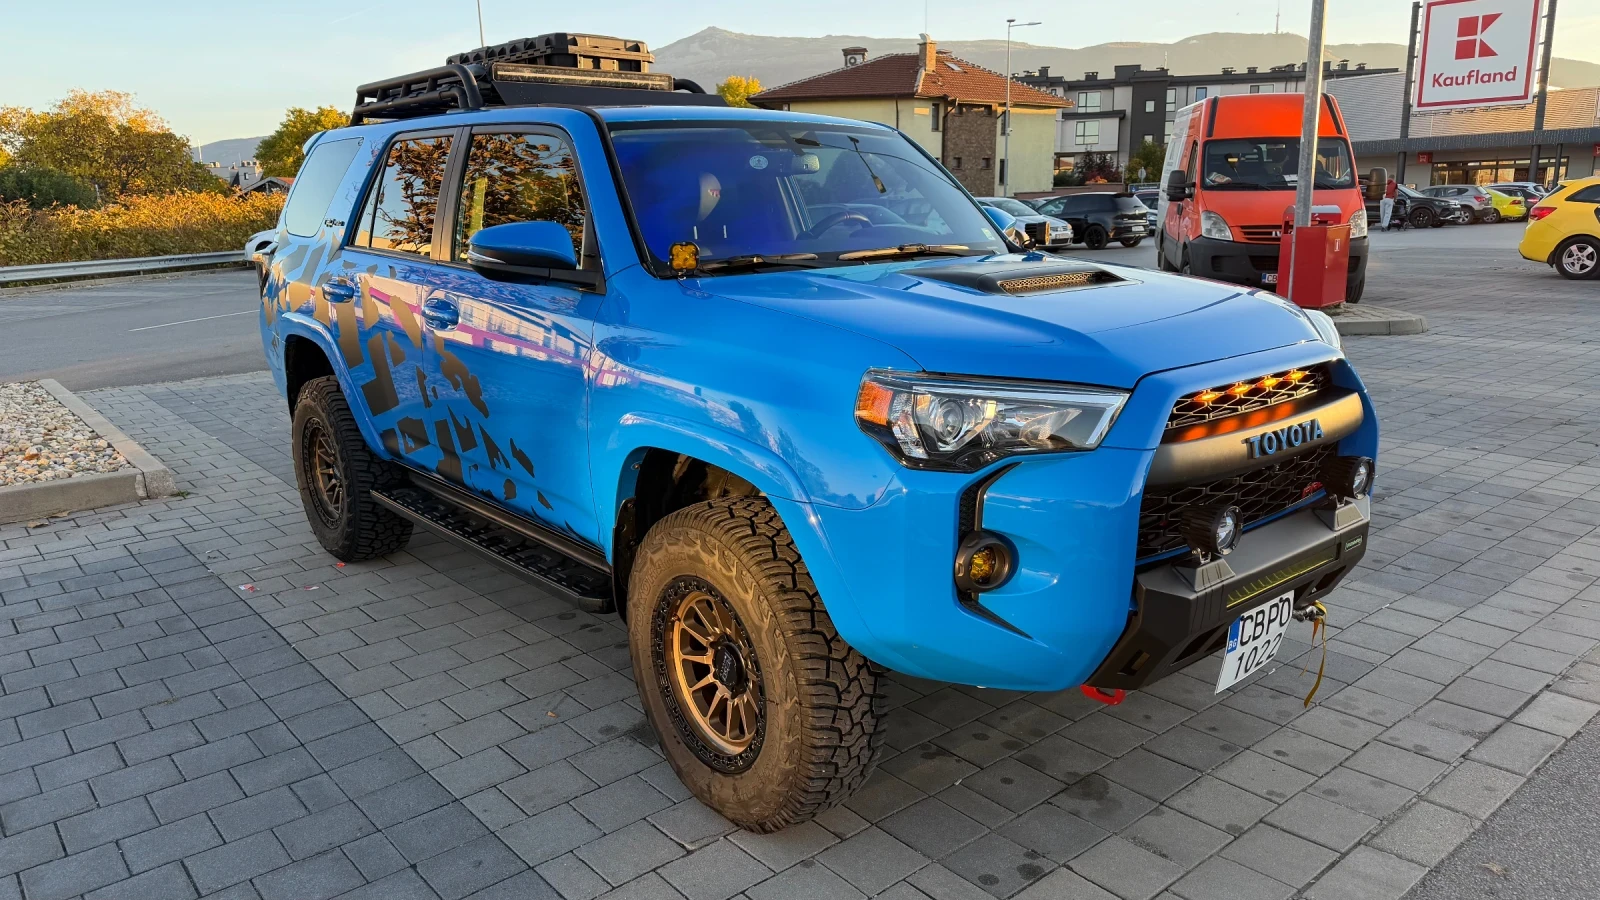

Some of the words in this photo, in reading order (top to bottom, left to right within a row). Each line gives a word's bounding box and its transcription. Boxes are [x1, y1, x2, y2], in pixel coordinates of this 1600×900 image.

[1432, 66, 1517, 88] Kaufland
[1247, 419, 1324, 459] TOYOTA
[1240, 597, 1291, 646] CBPO
[1227, 638, 1238, 650] BG
[1234, 632, 1283, 680] 1022
